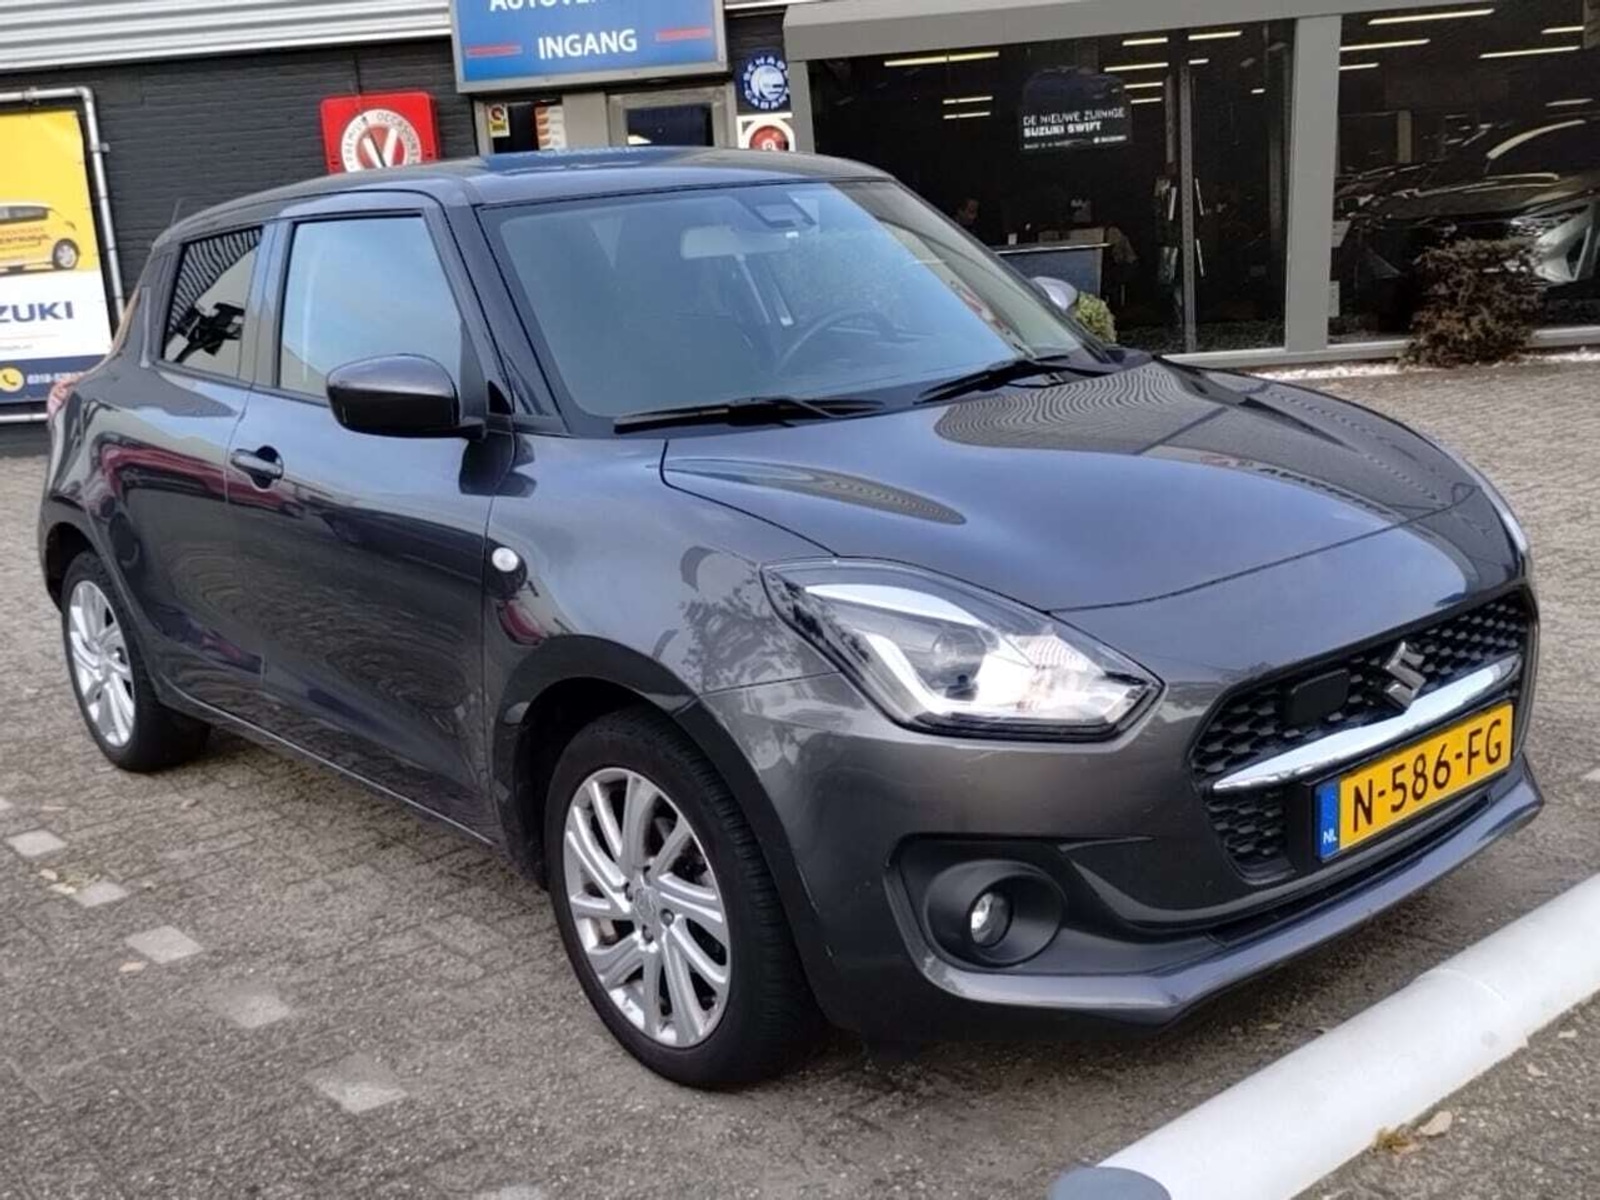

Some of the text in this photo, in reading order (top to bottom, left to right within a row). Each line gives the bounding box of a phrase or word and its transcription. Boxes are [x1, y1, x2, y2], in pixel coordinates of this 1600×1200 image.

[538, 28, 638, 60] INGANG
[1322, 718, 1501, 845] NL N-586-FG
